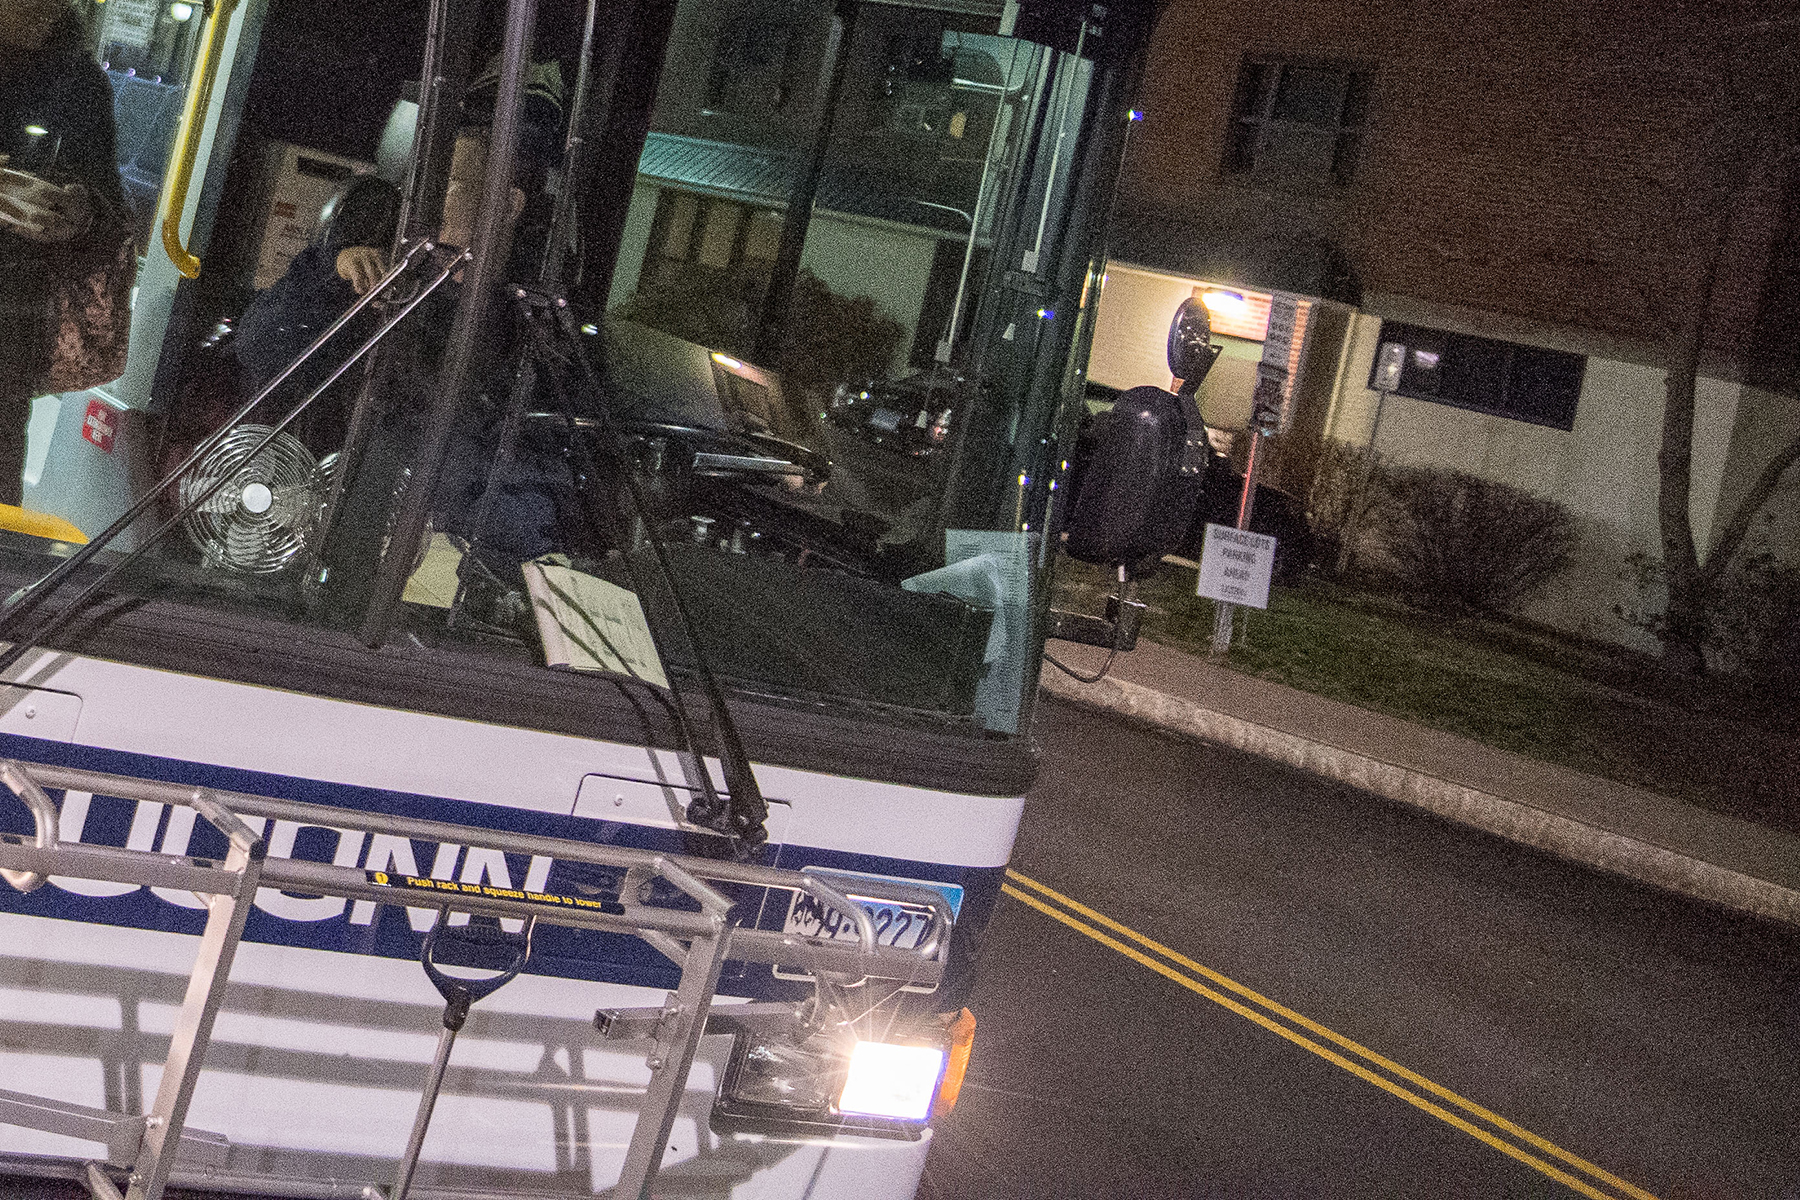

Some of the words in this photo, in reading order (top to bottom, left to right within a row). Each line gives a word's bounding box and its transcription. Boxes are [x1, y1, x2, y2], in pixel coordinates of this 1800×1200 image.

[406, 876, 435, 888] Push
[436, 881, 460, 891] rack
[461, 884, 481, 894] and
[482, 886, 525, 899] squeeze
[526, 891, 561, 903] handle
[561, 896, 574, 904] to
[574, 897, 602, 908] lower
